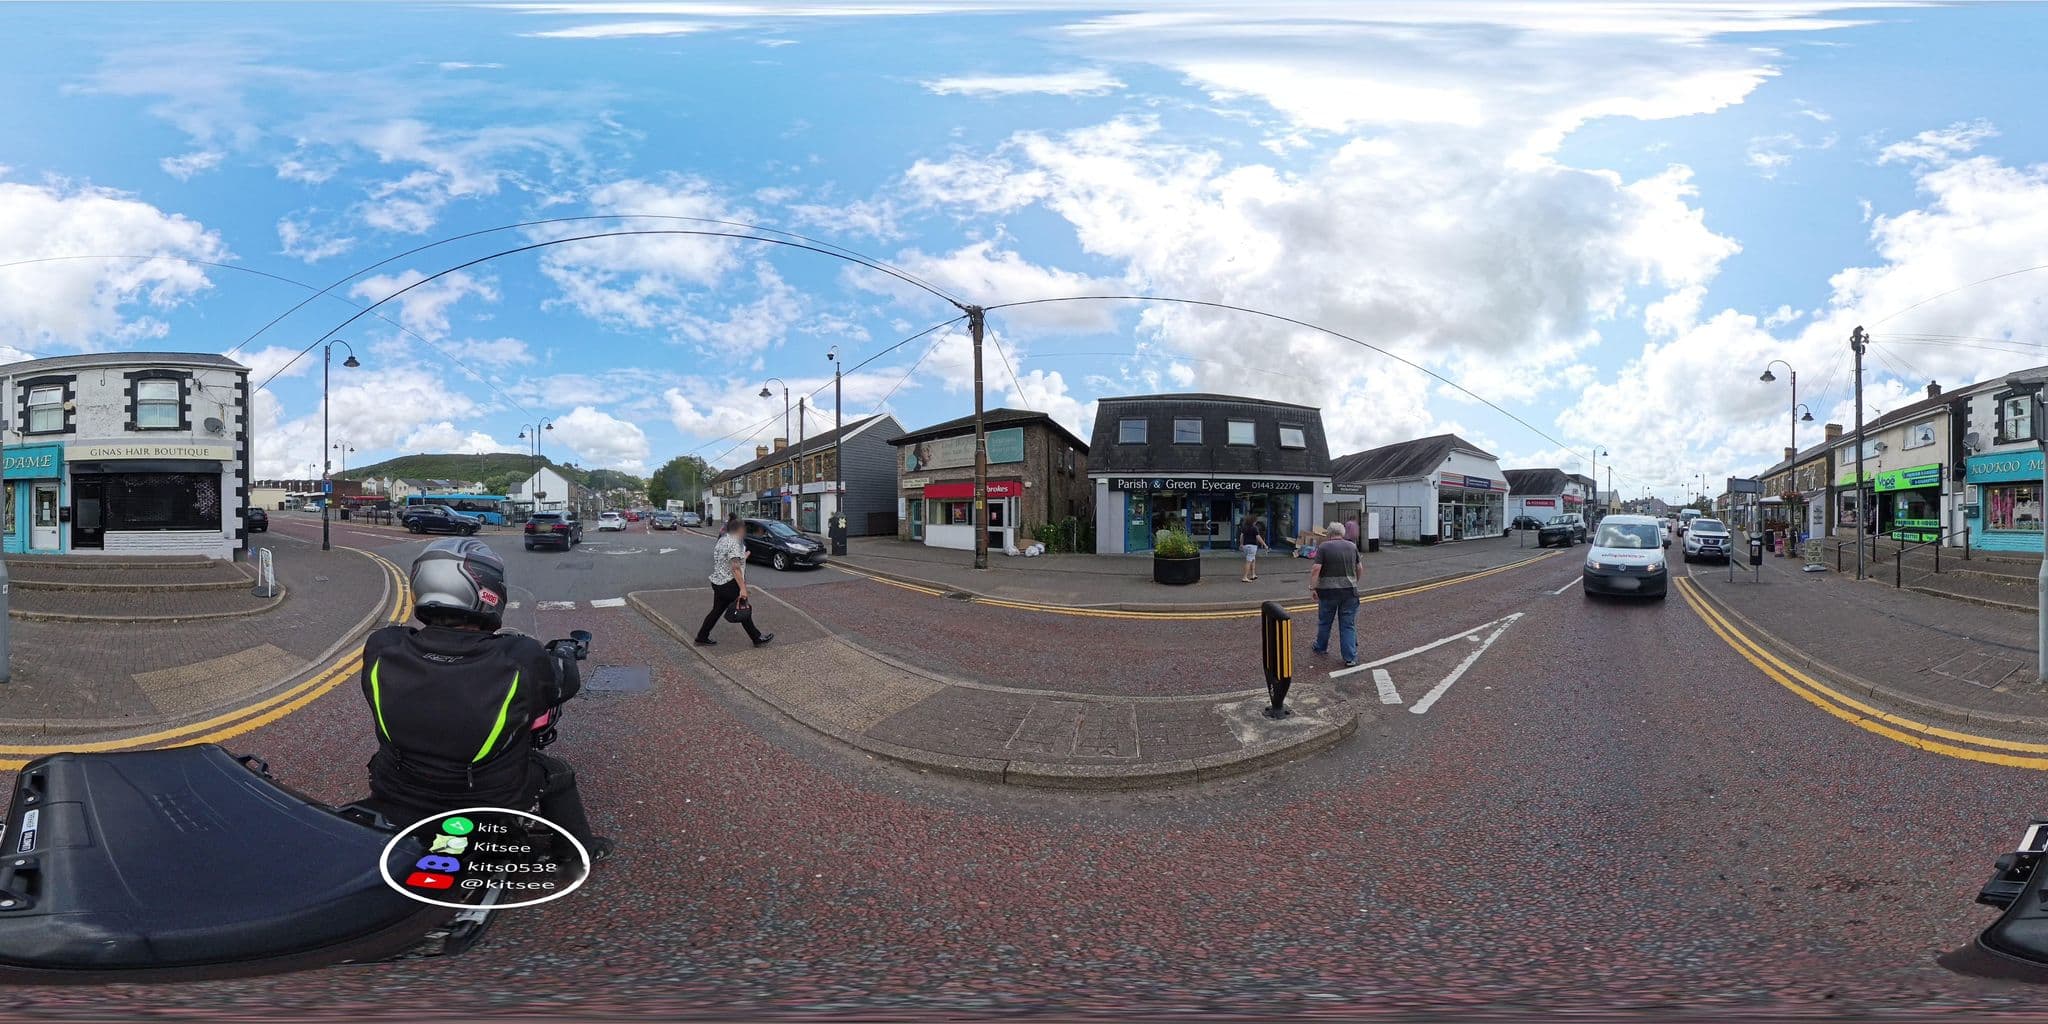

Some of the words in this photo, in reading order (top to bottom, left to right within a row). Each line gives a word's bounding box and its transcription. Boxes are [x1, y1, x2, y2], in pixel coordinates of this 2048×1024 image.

[90, 447, 122, 457] GINAS
[125, 447, 150, 456] HAIR
[154, 447, 210, 457] BOUTIQUE
[1971, 460, 2020, 475] KOOKOO
[986, 484, 1009, 493] brokes
[1117, 479, 1148, 489] Parish
[1153, 480, 1161, 489] &
[1166, 479, 1197, 489] Green
[1201, 480, 1241, 491] Eyecare
[1251, 481, 1274, 489] 01443
[1275, 482, 1300, 490] 222776
